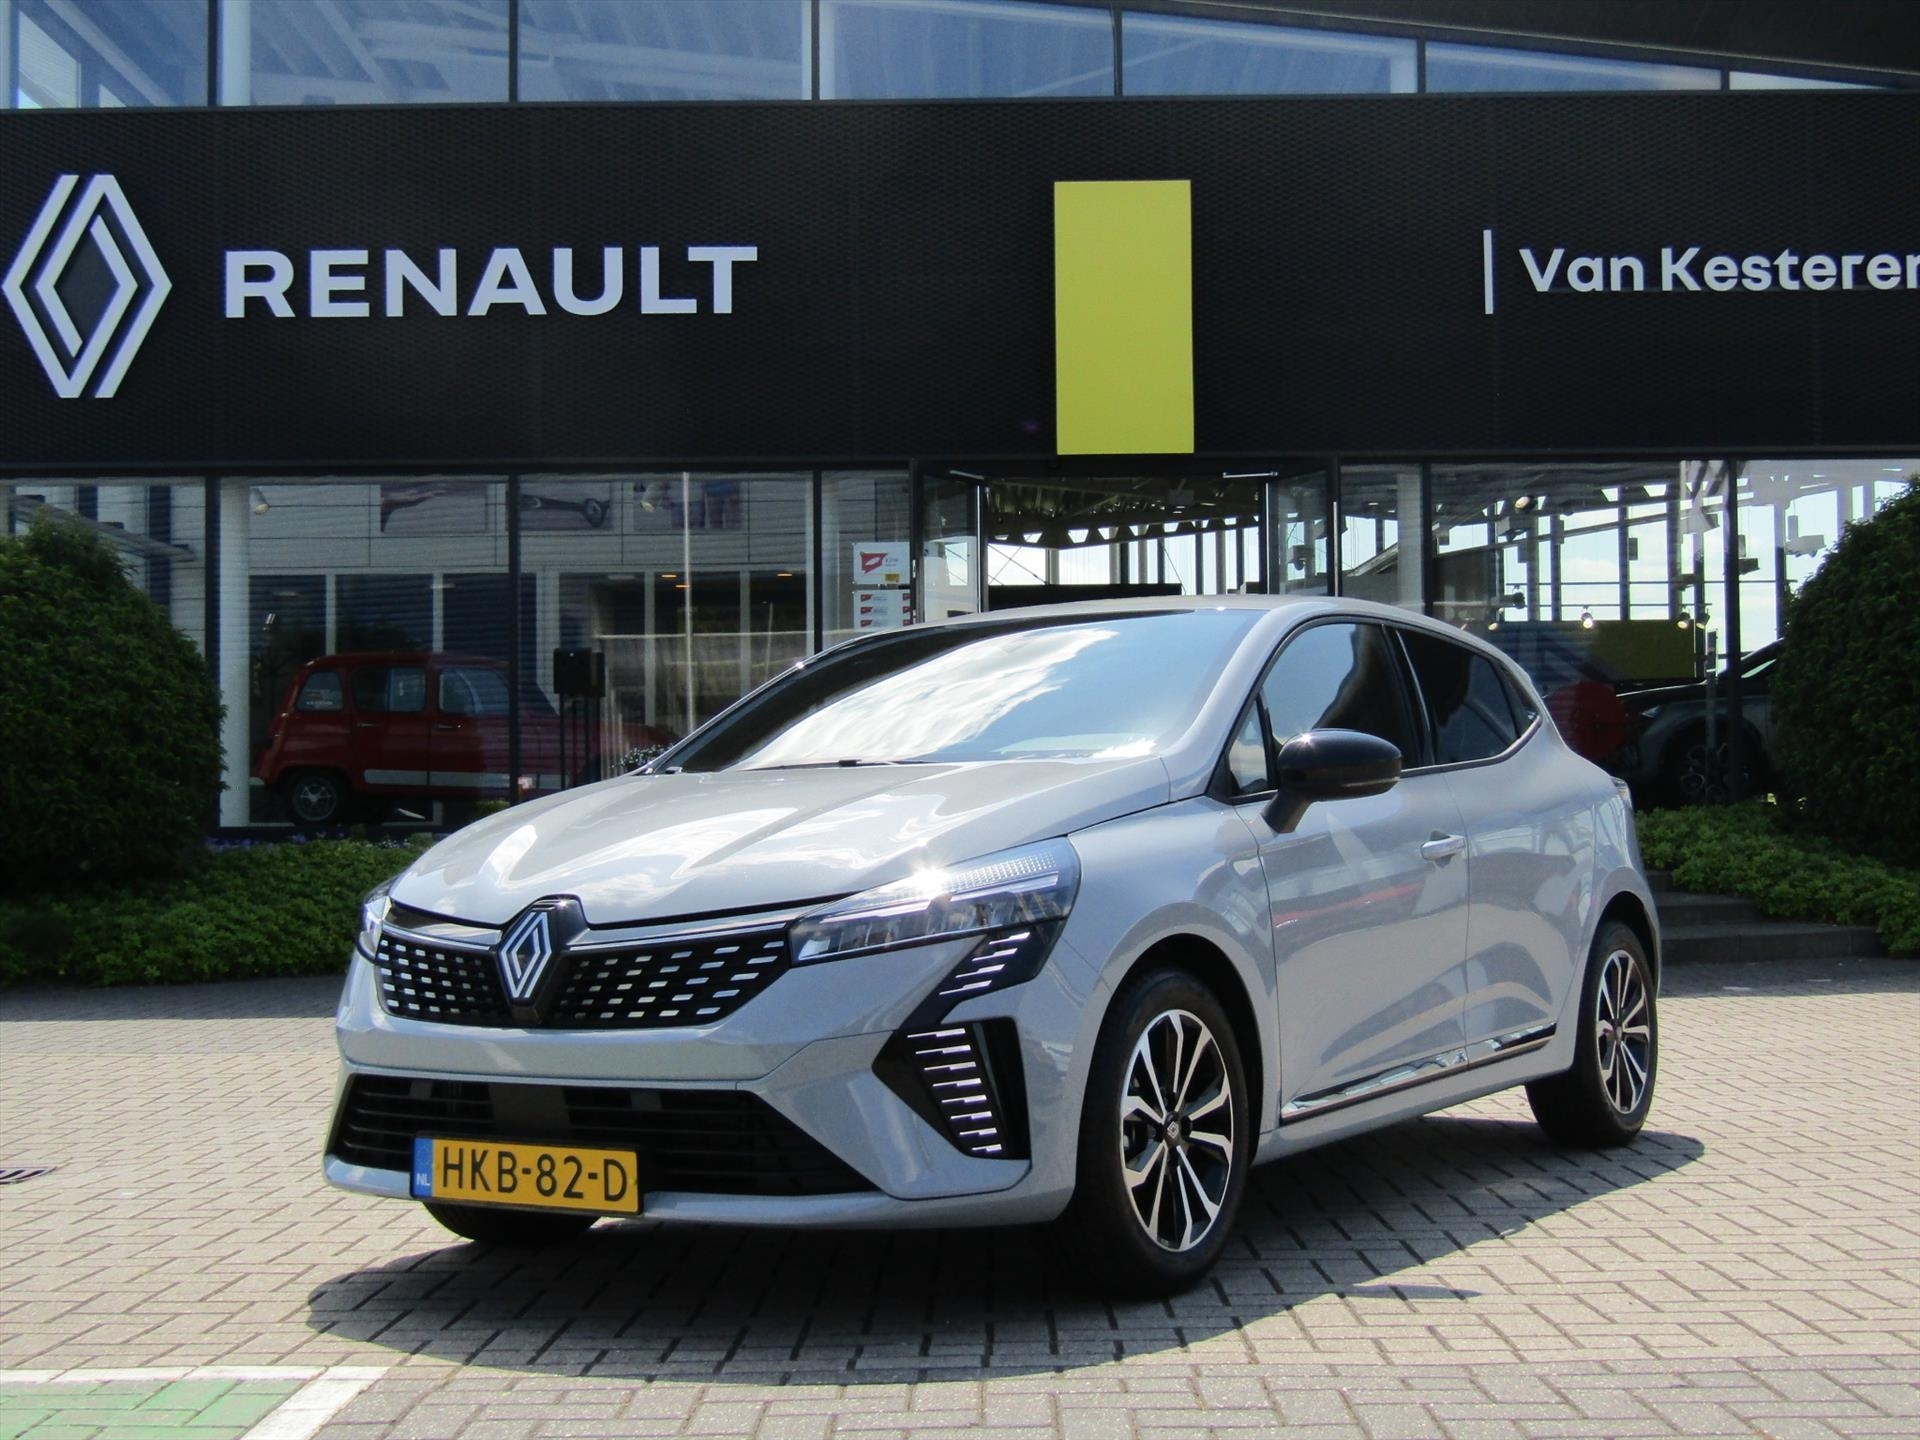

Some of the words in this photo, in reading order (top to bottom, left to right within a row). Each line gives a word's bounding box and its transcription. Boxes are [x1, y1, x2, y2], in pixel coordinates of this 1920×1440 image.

[224, 246, 758, 319] RENAULT
[1518, 248, 1645, 293] Van
[416, 1172, 431, 1187] NL
[442, 1146, 628, 1202] HKB-82-D
